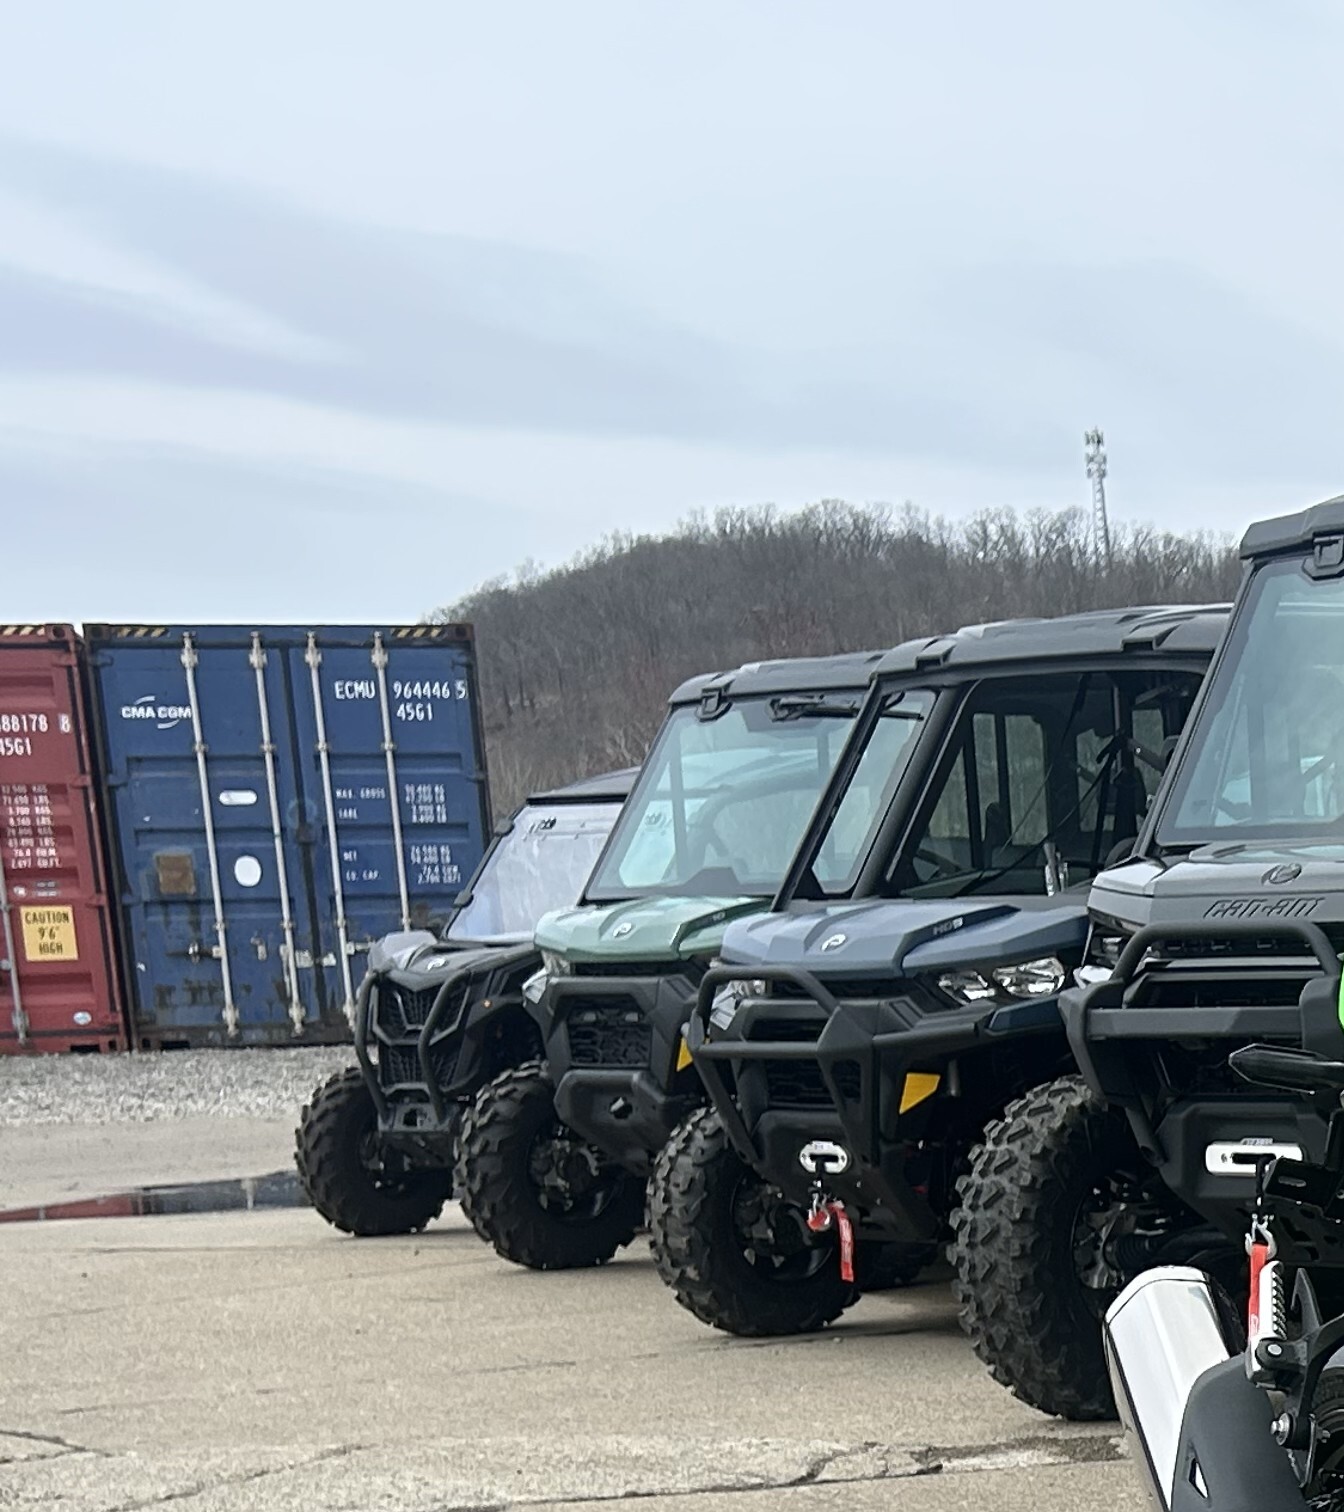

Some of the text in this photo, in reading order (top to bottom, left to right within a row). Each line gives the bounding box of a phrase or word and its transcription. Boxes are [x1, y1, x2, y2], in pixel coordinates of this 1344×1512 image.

[334, 680, 376, 699] ECMU
[393, 681, 450, 699] 964446
[121, 706, 192, 719] CMA CGM
[396, 702, 433, 721] 45G1
[0, 714, 48, 733] 88178
[25, 911, 69, 925] CAUTION
[38, 942, 63, 955] HIGH
